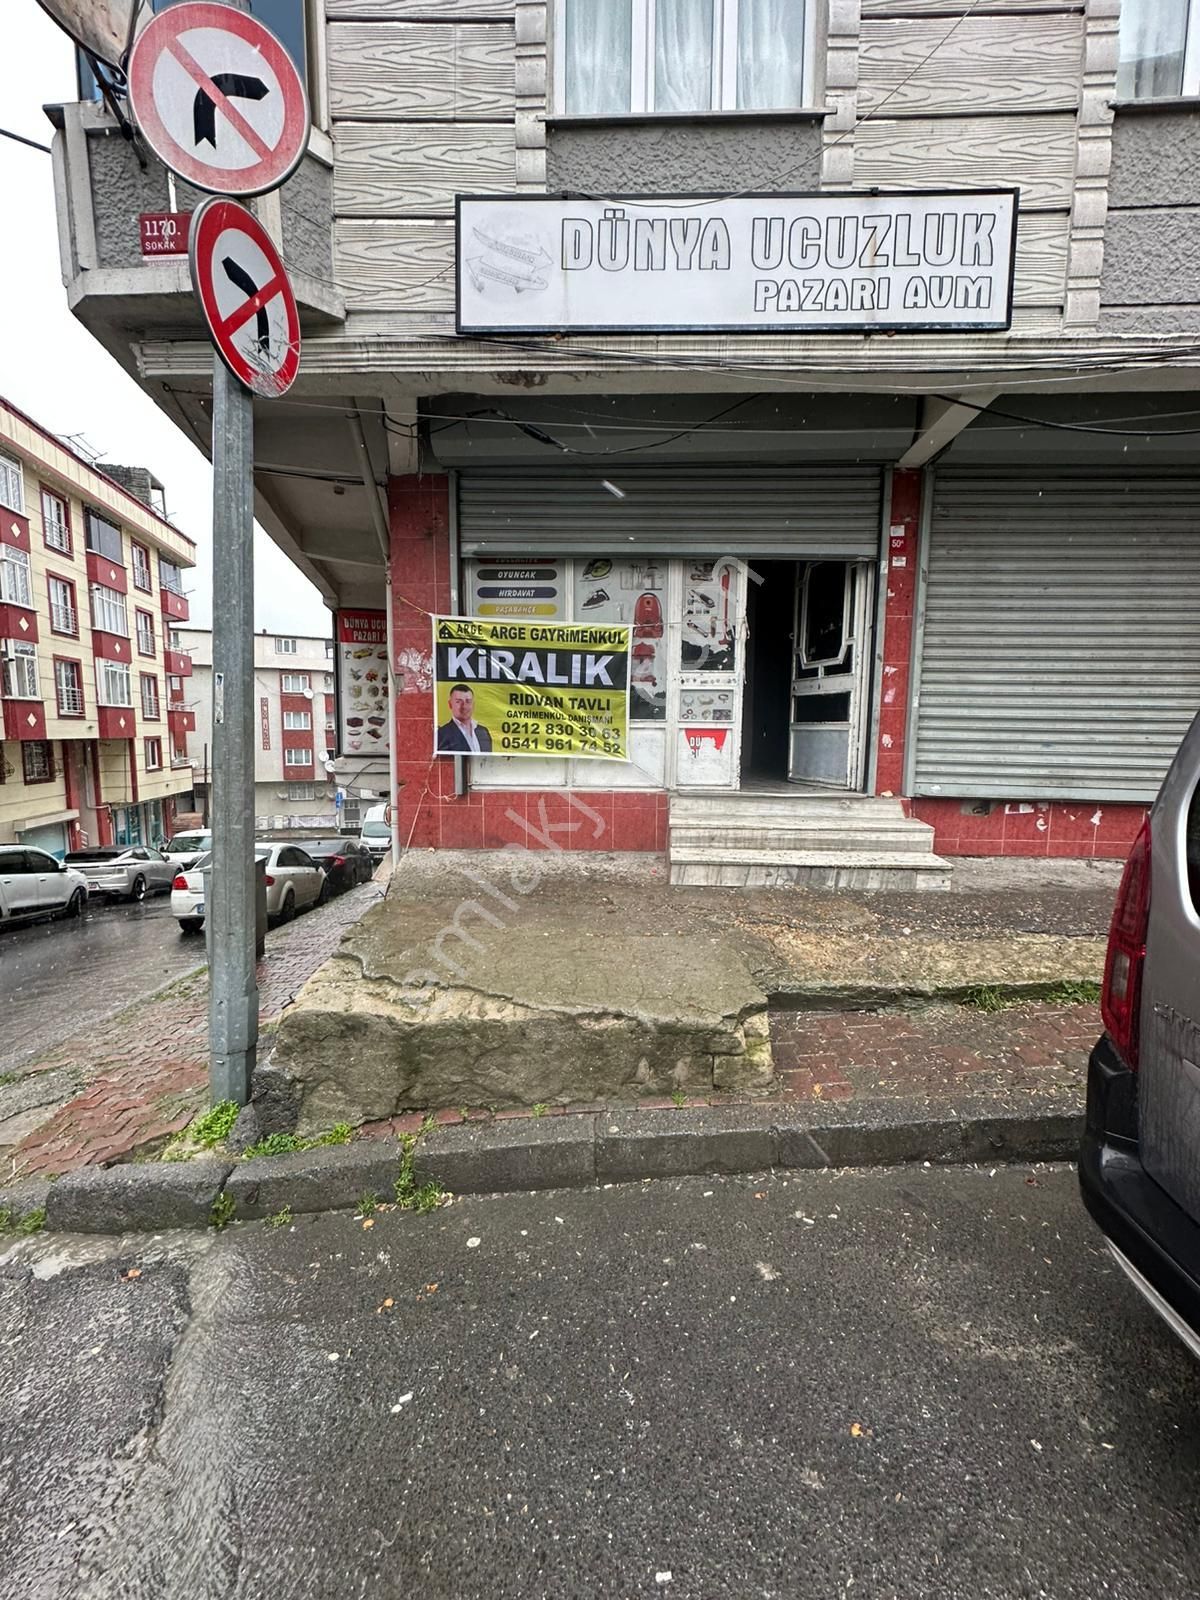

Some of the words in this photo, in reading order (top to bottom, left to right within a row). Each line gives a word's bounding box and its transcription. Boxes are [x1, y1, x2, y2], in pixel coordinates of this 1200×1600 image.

[144, 219, 181, 236] 1170.
[145, 241, 176, 250] SOKAK
[561, 208, 731, 271] DÜNYA
[751, 213, 997, 270] UCUZLUK
[753, 276, 890, 312] PAZARI
[903, 275, 993, 309] AVM
[497, 571, 537, 579] OYUNCAK
[498, 589, 535, 597] HIRDAVAT
[456, 624, 483, 636] ARGE
[490, 626, 526, 640] ARGE
[509, 693, 563, 708] RIDVAN
[568, 697, 610, 711] TAVLI
[501, 721, 540, 735] 0212
[545, 723, 574, 736] 830
[579, 726, 597, 738] 30
[601, 728, 620, 739] 63
[501, 736, 539, 749] 0541
[545, 738, 572, 750] 961
[580, 740, 597, 751] 74
[603, 742, 620, 754] 52
